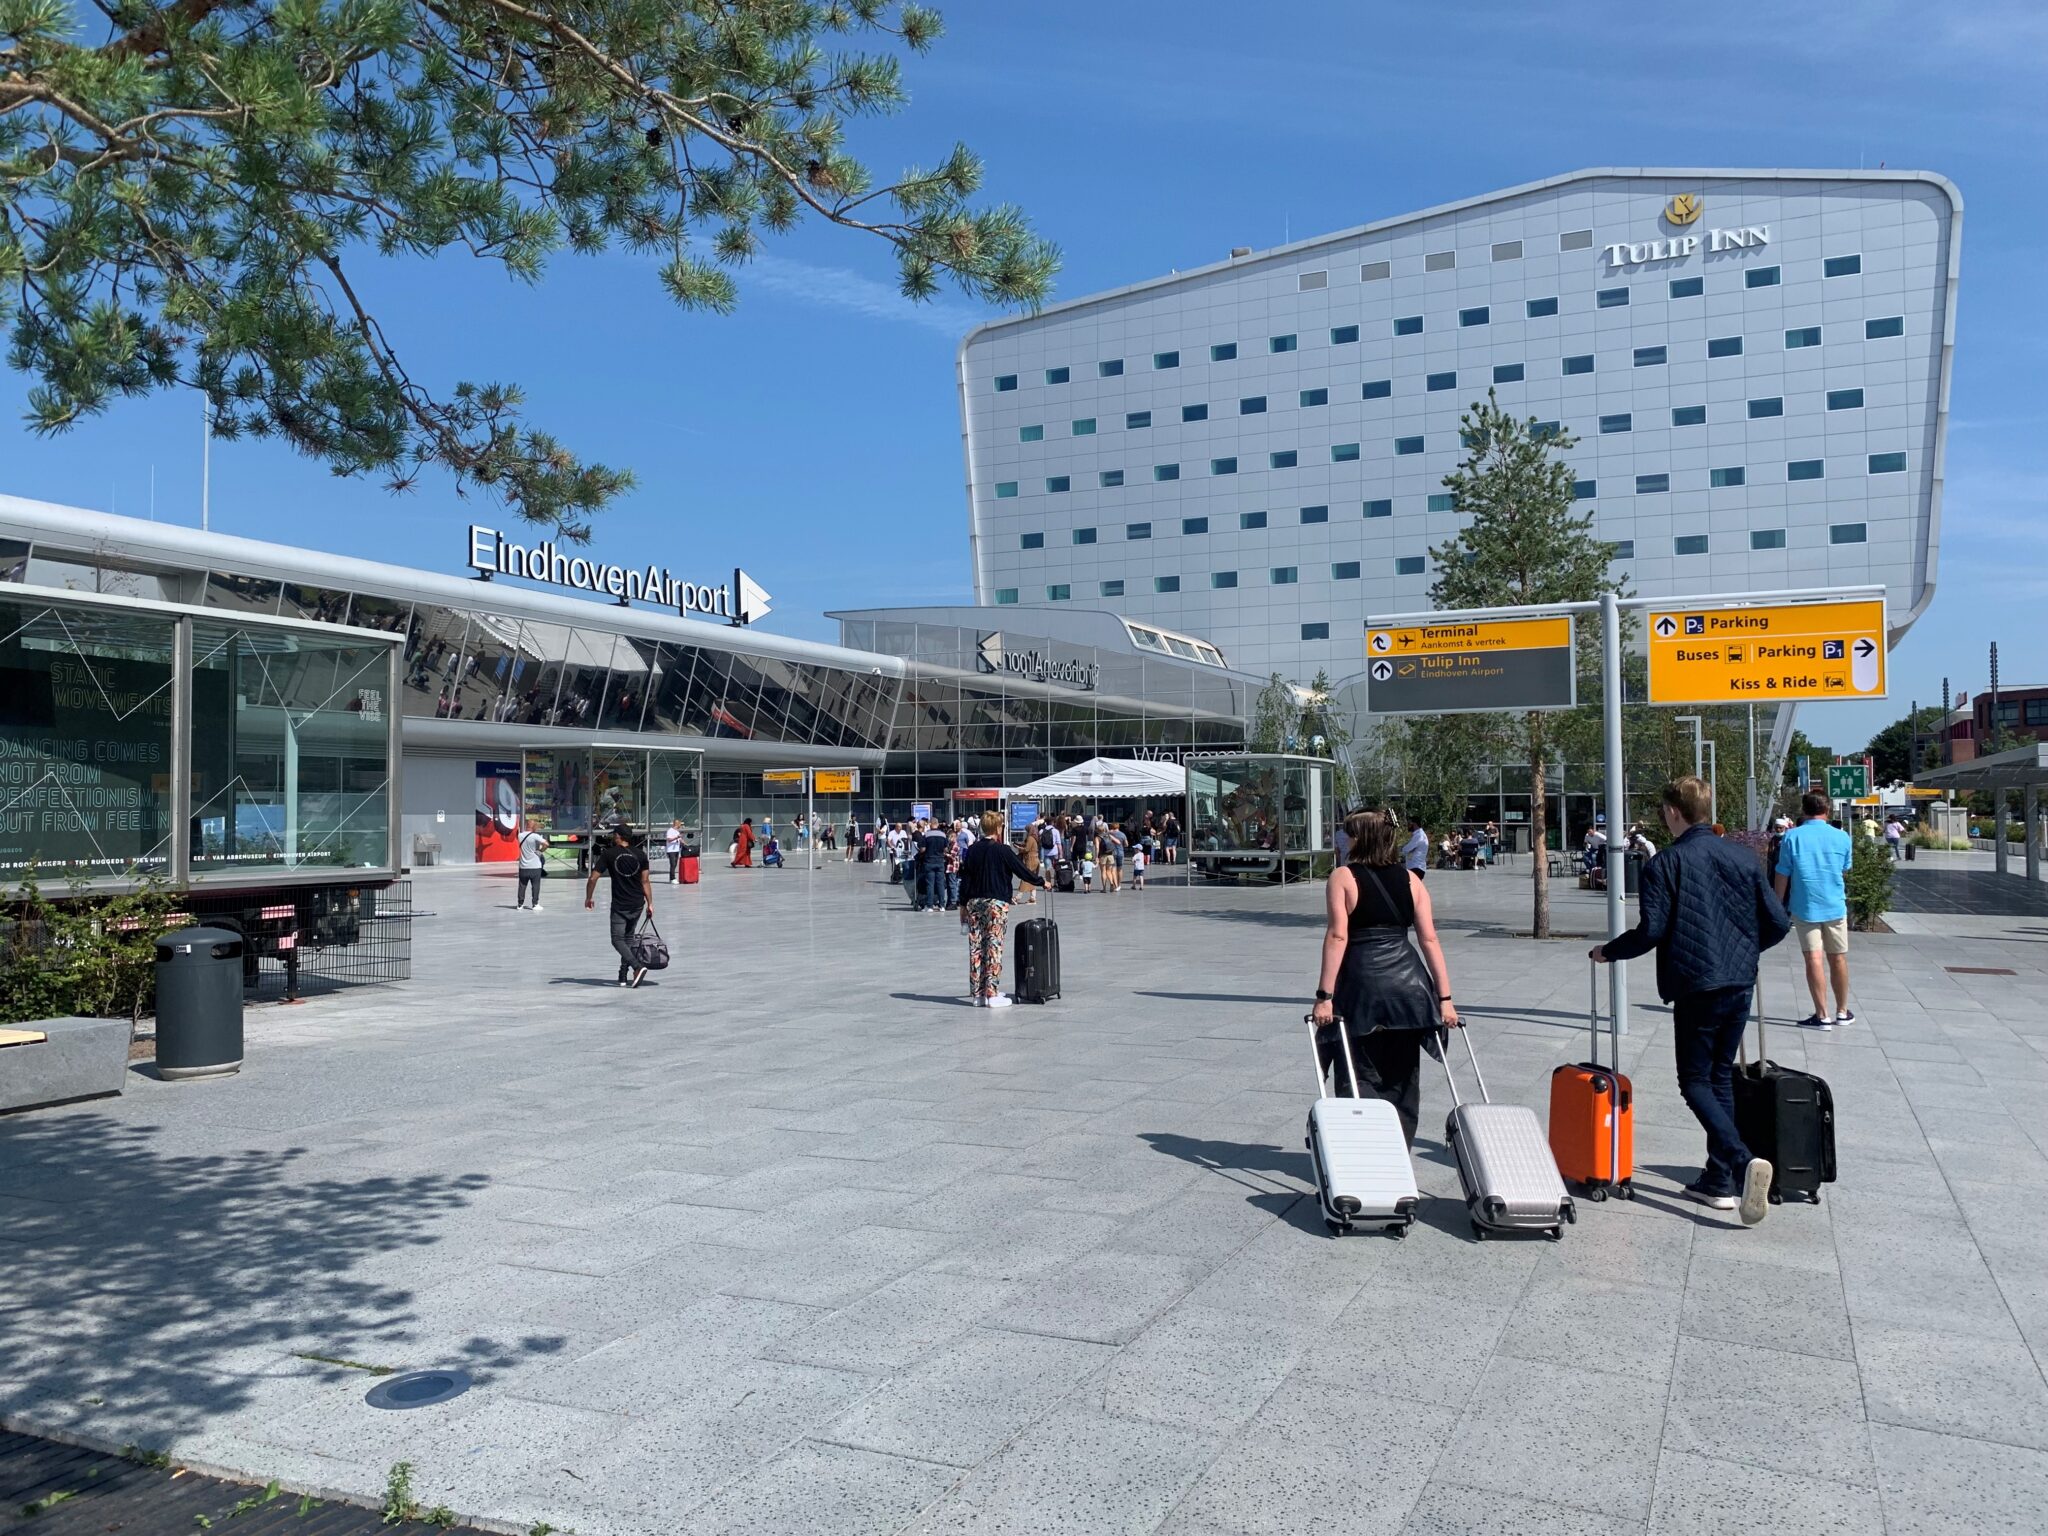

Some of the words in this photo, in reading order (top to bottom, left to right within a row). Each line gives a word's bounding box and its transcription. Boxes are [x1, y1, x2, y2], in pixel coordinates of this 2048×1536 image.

[1605, 236, 1699, 267] TULIP
[1708, 225, 1770, 253] INN
[1710, 616, 1769, 630] Parking
[1420, 624, 1478, 639] Terminal
[1420, 638, 1464, 649] Aankomst
[1466, 639, 1473, 647] &
[1475, 637, 1507, 646] vertrek
[1677, 650, 1719, 661] Buses
[1758, 645, 1816, 659] Parking
[1420, 656, 1454, 669] Tulip
[1458, 655, 1481, 666] Inn
[50, 661, 117, 688] STATIC
[1420, 668, 1469, 678] Eindhoven
[1471, 667, 1504, 677] Airport
[1730, 677, 1760, 690] Kiss
[1766, 677, 1777, 689] &
[1783, 676, 1817, 689] Ride
[52, 684, 171, 716] MOVEMENTS
[94, 740, 161, 763] COMES
[44, 763, 101, 785] FROM
[41, 811, 99, 832] FROM
[105, 810, 171, 831] FEELIN
